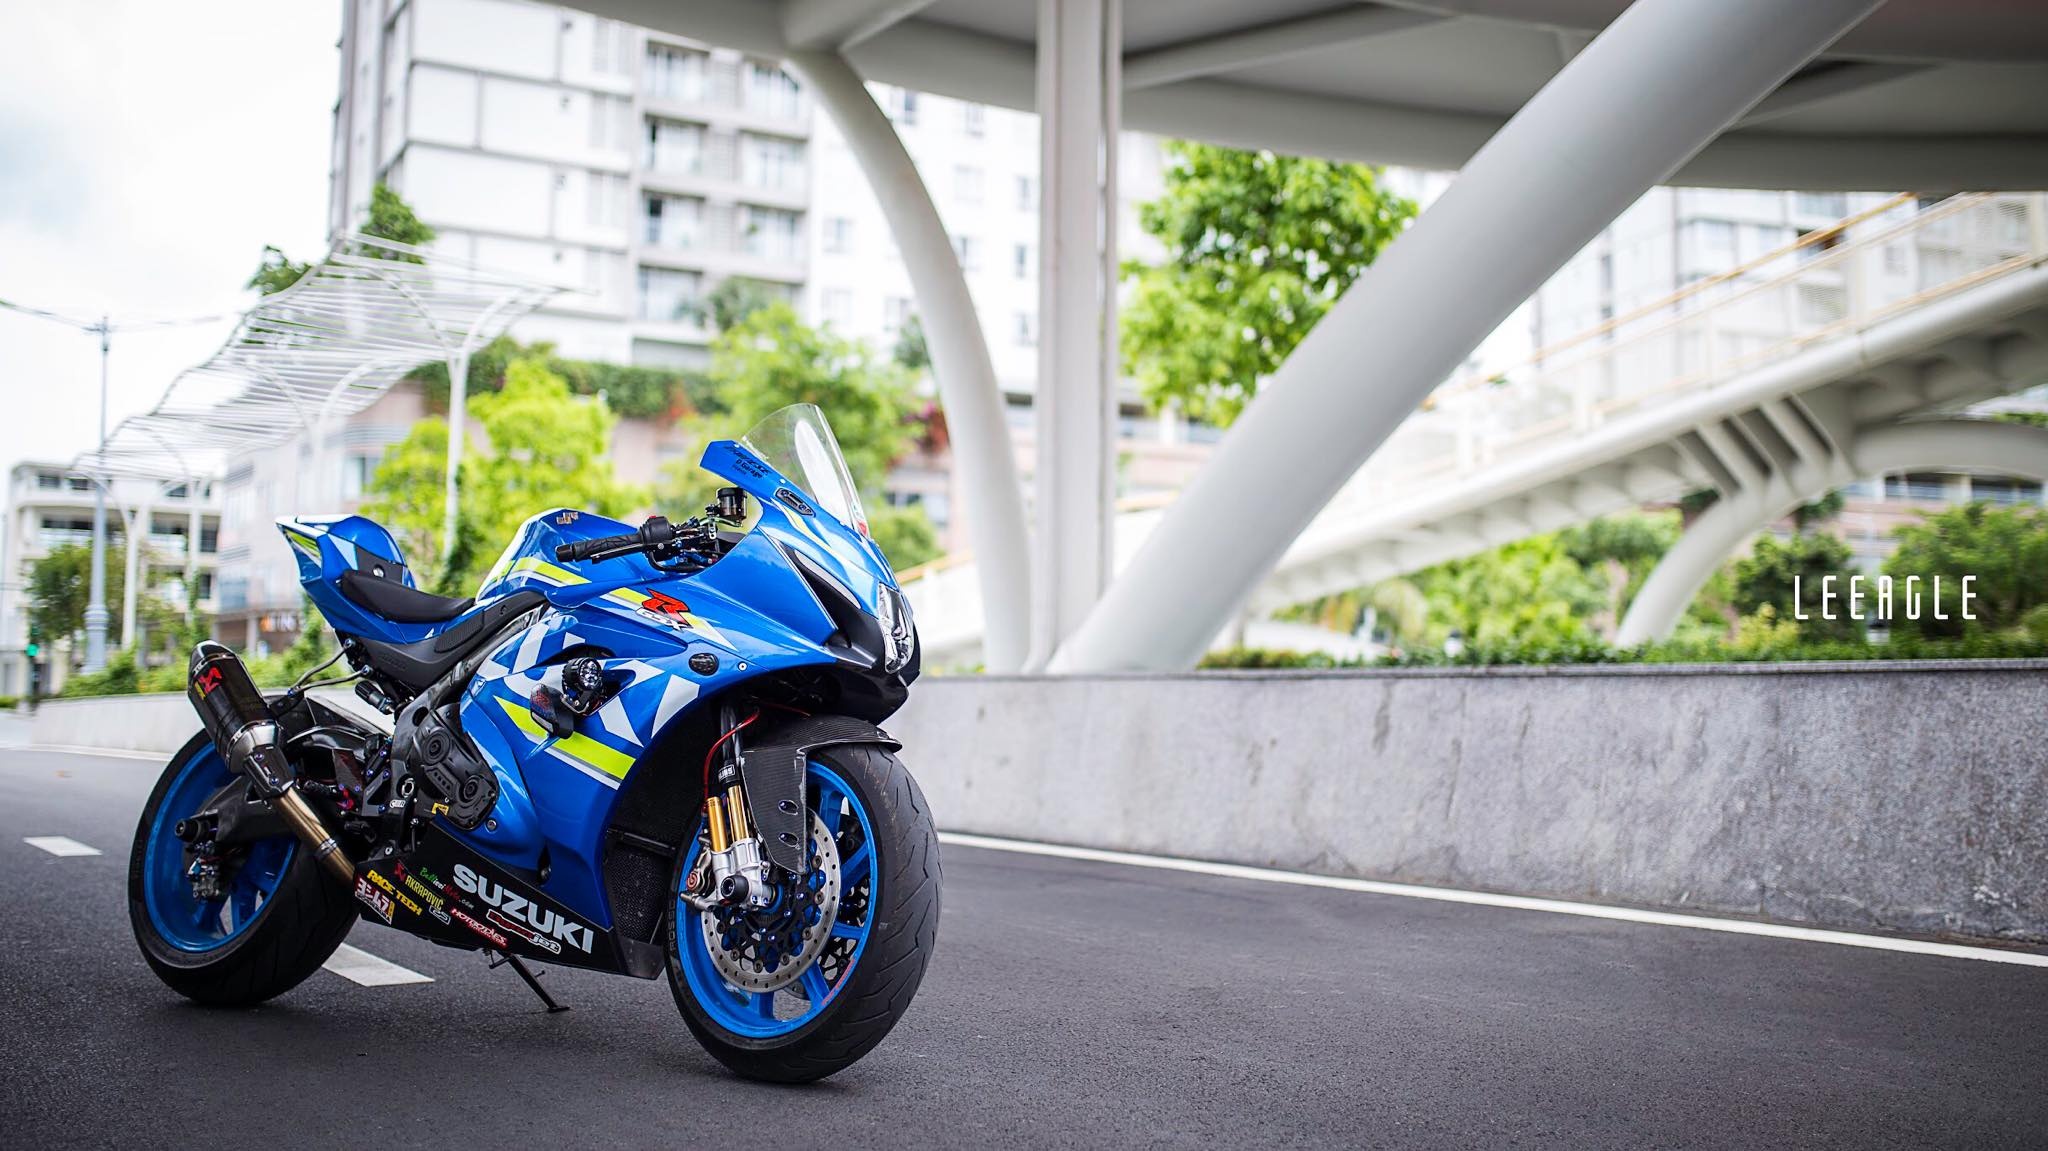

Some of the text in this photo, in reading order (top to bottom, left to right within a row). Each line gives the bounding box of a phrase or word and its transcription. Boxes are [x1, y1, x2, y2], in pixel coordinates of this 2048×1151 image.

[366, 869, 396, 895] RACE
[396, 890, 422, 916] TECH
[453, 863, 594, 954] SUZUKI
